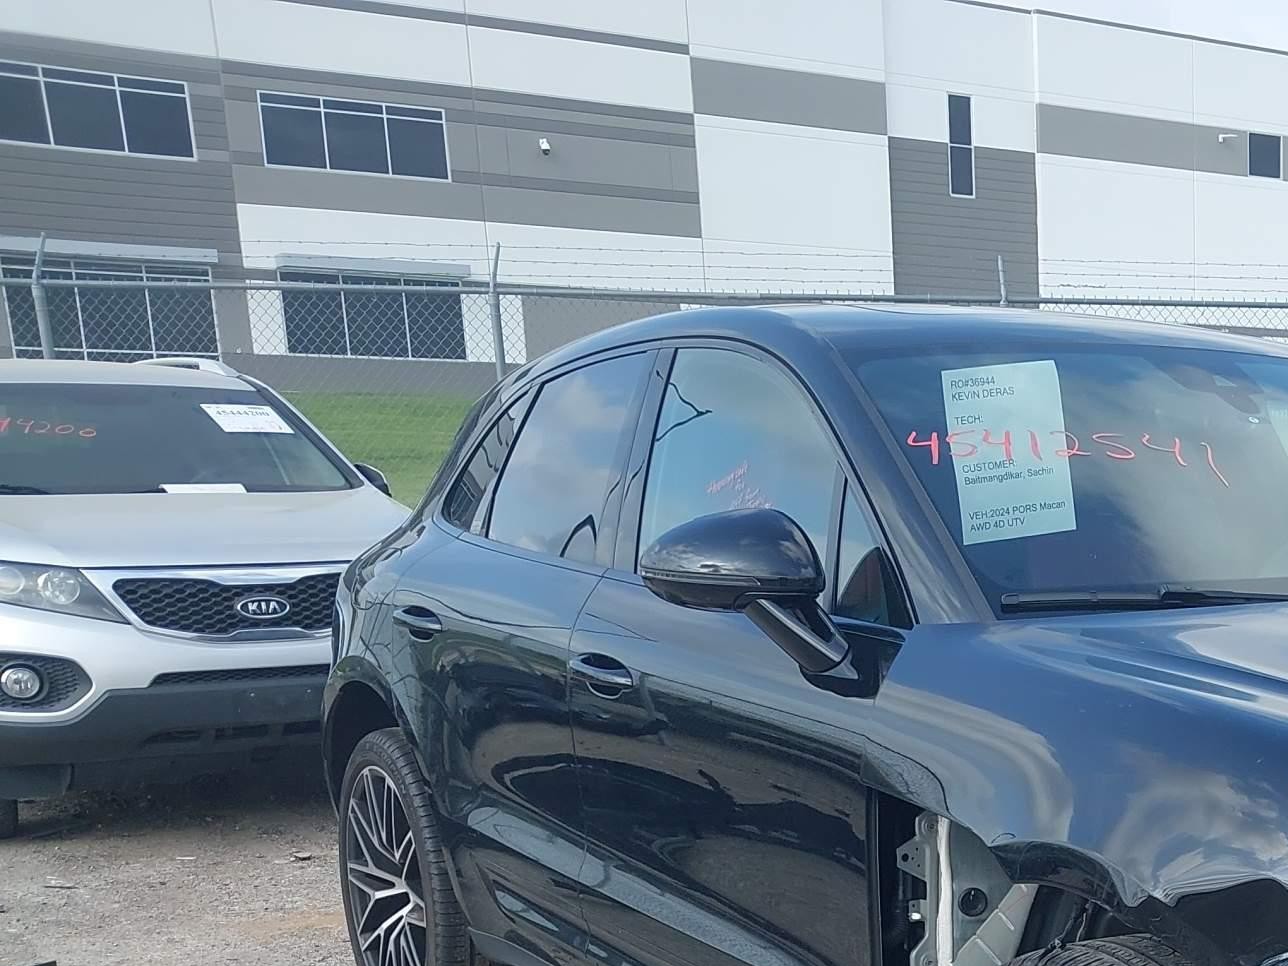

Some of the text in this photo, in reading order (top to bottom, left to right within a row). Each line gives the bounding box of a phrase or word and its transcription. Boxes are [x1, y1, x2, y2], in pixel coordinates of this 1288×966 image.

[950, 376, 996, 390] RO#36944
[951, 386, 1015, 401] KEVIN DERAS
[953, 415, 984, 425] TECH:
[906, 428, 1230, 488] 45412541
[1026, 466, 1054, 477] Sachin
[968, 500, 1066, 521] VEH:2024 PORS Macan
[969, 517, 1026, 533] AWD 4D UTV
[247, 601, 281, 614] KIA
